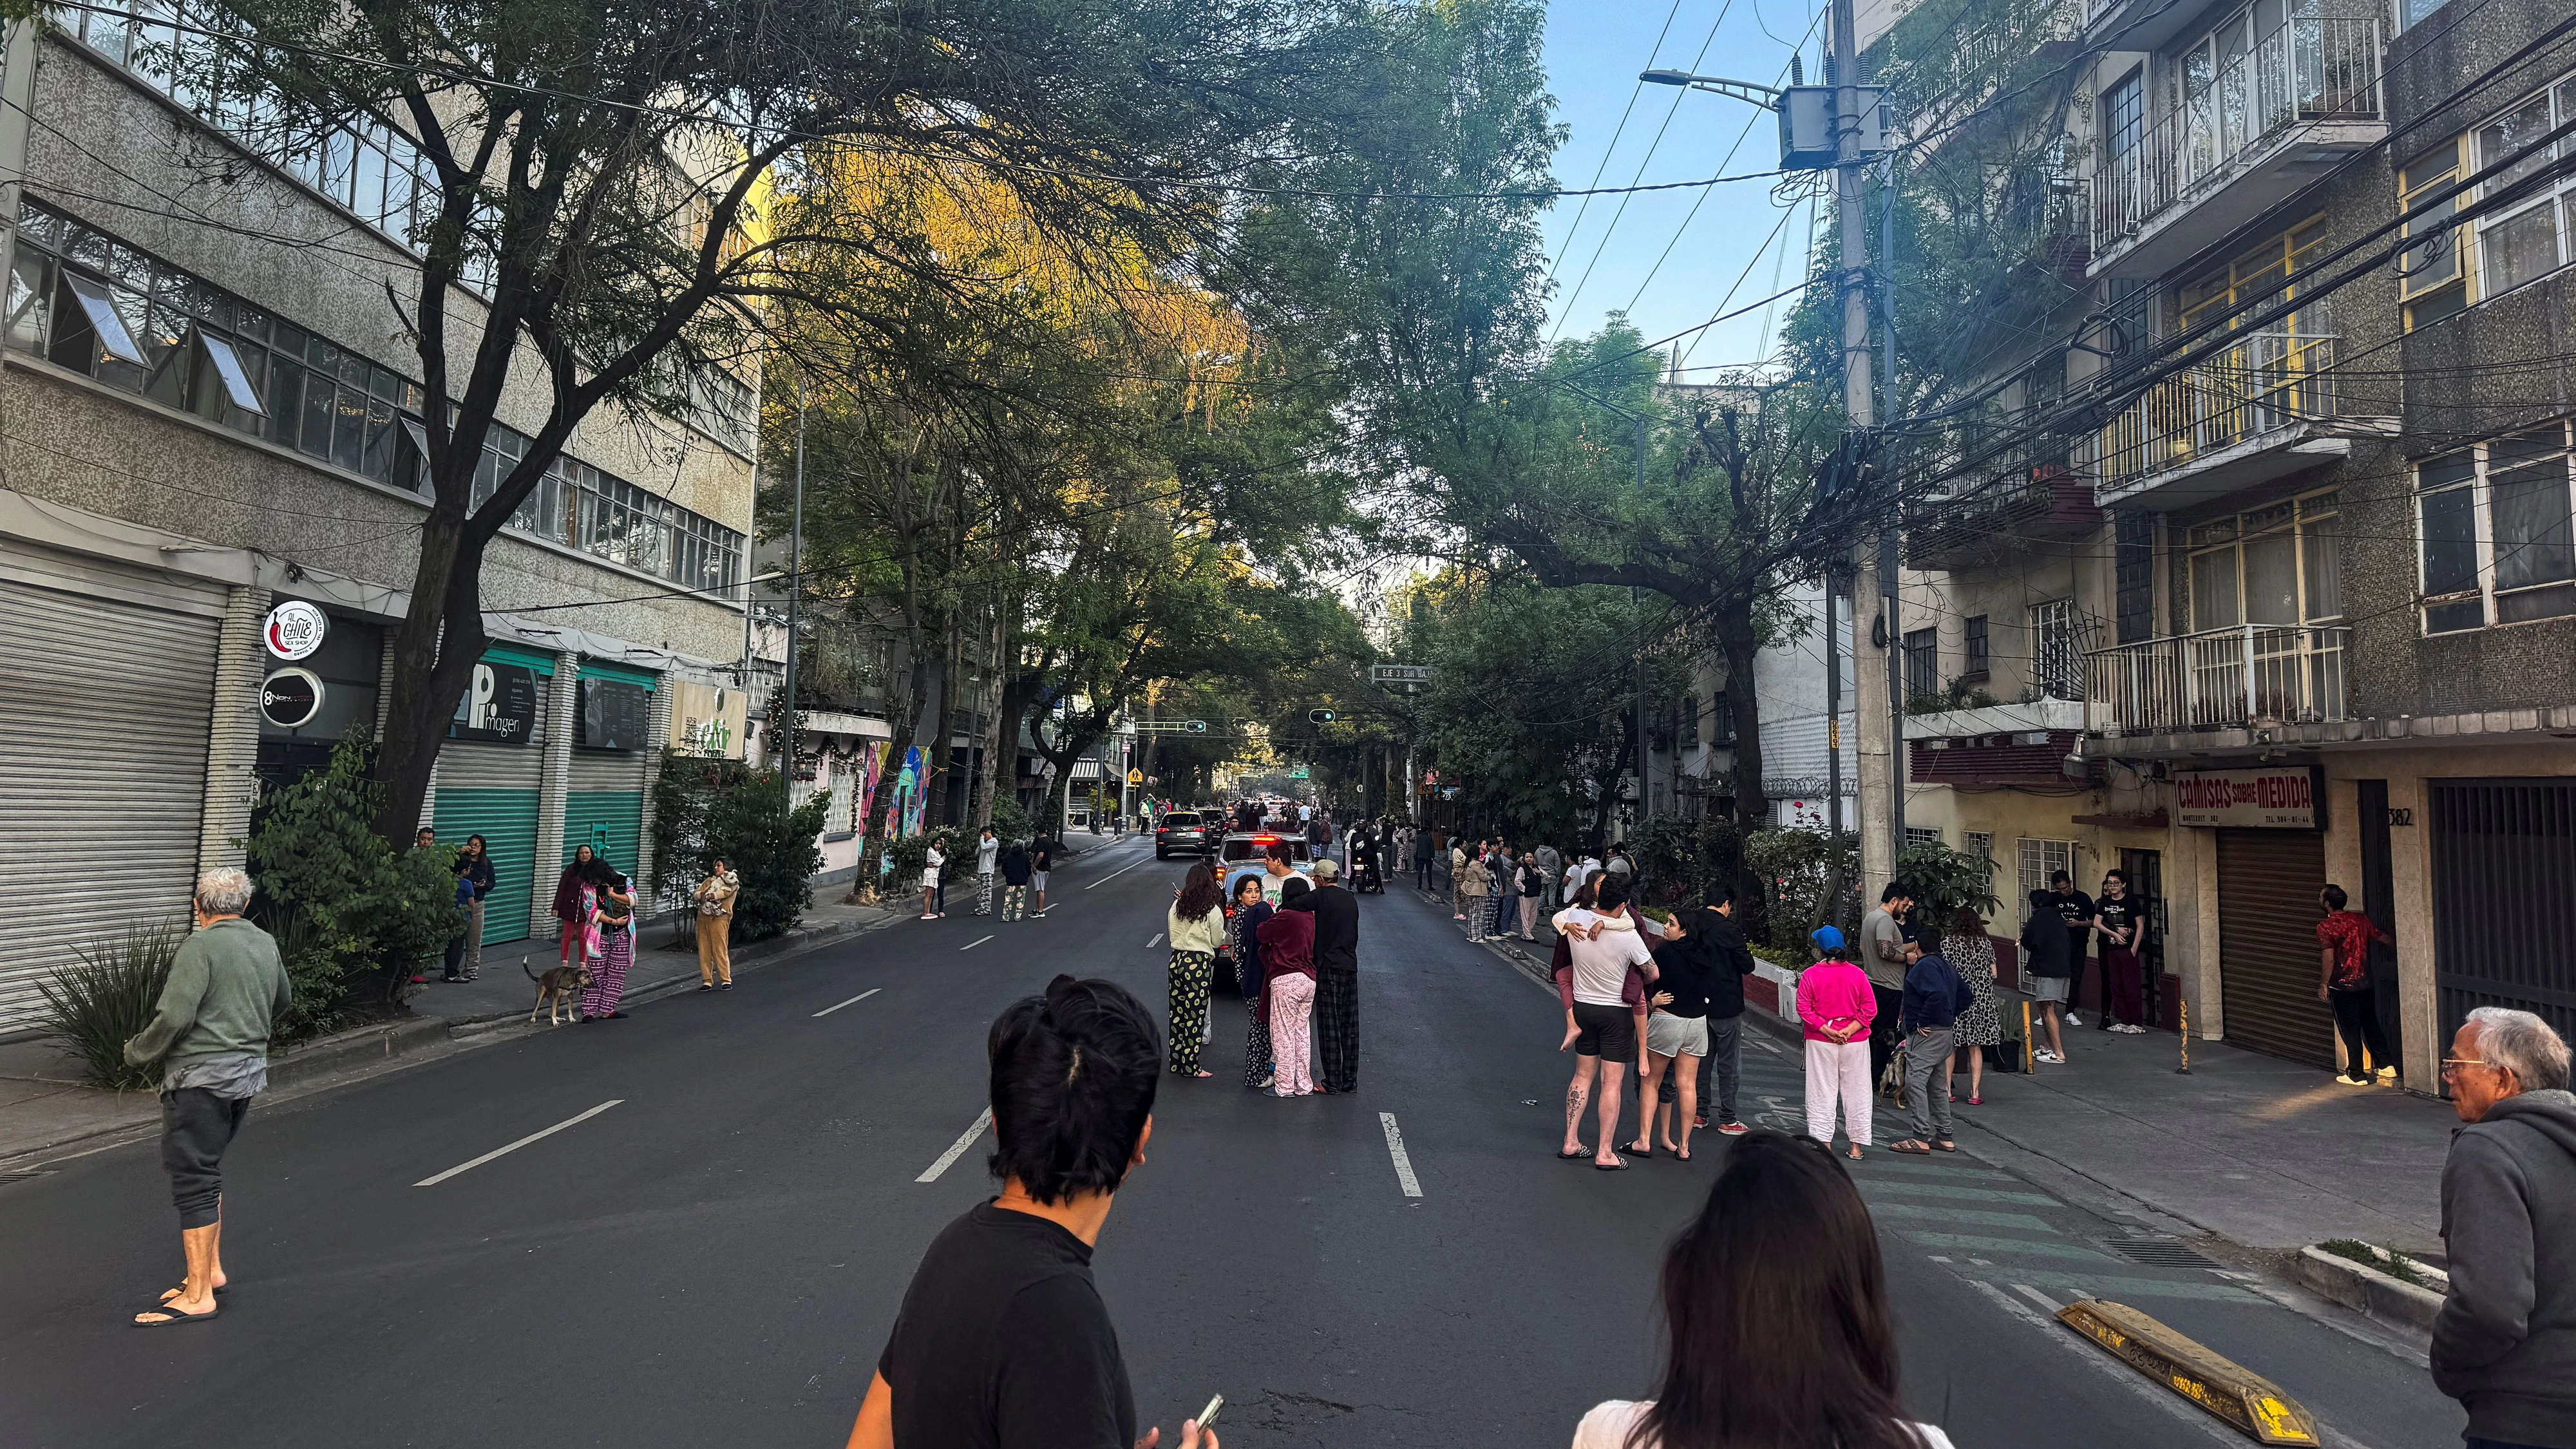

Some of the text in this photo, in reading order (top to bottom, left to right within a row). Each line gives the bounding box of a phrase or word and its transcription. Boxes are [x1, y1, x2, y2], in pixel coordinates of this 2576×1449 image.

[288, 612, 296, 622] AL
[283, 618, 312, 639] CHILE
[1403, 670, 1415, 678] SUR
[2178, 773, 2311, 809] CAMISAS SOBRE MEDIDA
[2389, 808, 2414, 826] 382
